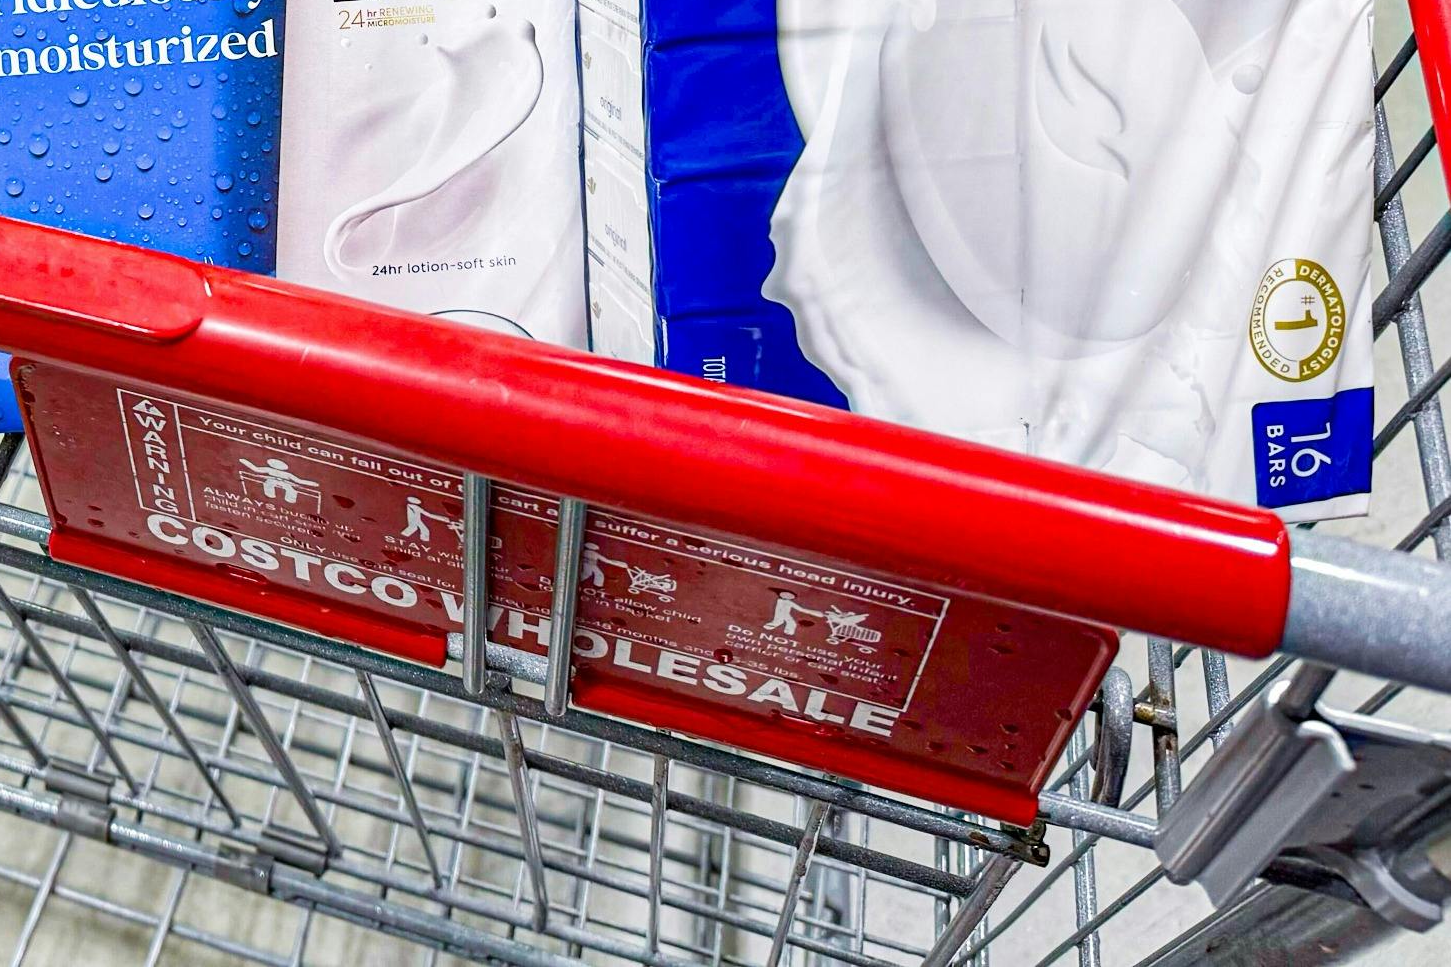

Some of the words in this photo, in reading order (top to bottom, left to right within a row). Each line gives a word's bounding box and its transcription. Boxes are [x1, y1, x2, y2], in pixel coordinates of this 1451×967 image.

[338, 9, 365, 30] 24
[367, 9, 377, 18] hr
[372, 263, 403, 276] 24hr
[407, 256, 484, 274] lotion-soft
[489, 254, 517, 267] skin
[1252, 266, 1292, 375] RECOMMENDED
[1298, 264, 1342, 377] DERMATOLOGIST
[134, 412, 179, 514] WARNING
[199, 417, 247, 436] Your
[253, 433, 301, 450] child
[307, 446, 344, 462] can
[350, 456, 381, 471] fall
[389, 468, 423, 482] out
[430, 477, 451, 489] of
[498, 495, 540, 512] cart
[1267, 424, 1285, 488] BARS
[1291, 422, 1332, 477] 16
[204, 486, 276, 511] ALWAYS
[205, 500, 250, 518] fasten
[147, 514, 418, 608] COSTCO
[280, 536, 326, 553] ONLY
[332, 551, 359, 564] use
[398, 568, 431, 583] seat
[384, 535, 431, 552] STAY
[595, 520, 660, 541] suffer
[666, 538, 678, 546] a
[686, 544, 771, 569] serious
[778, 563, 836, 585] head
[843, 582, 916, 607] injury.
[614, 596, 657, 612] allow
[663, 608, 701, 624] child
[441, 591, 900, 737] WHOLESALE
[725, 640, 779, 659] carrier
[784, 655, 801, 664] or
[807, 662, 832, 673] car
[725, 633, 762, 646] own
[767, 643, 843, 667] personal
[848, 664, 898, 681] infant
[727, 624, 754, 636] Do
[759, 633, 800, 648] NOT
[806, 645, 838, 658] use
[844, 655, 883, 671] your
